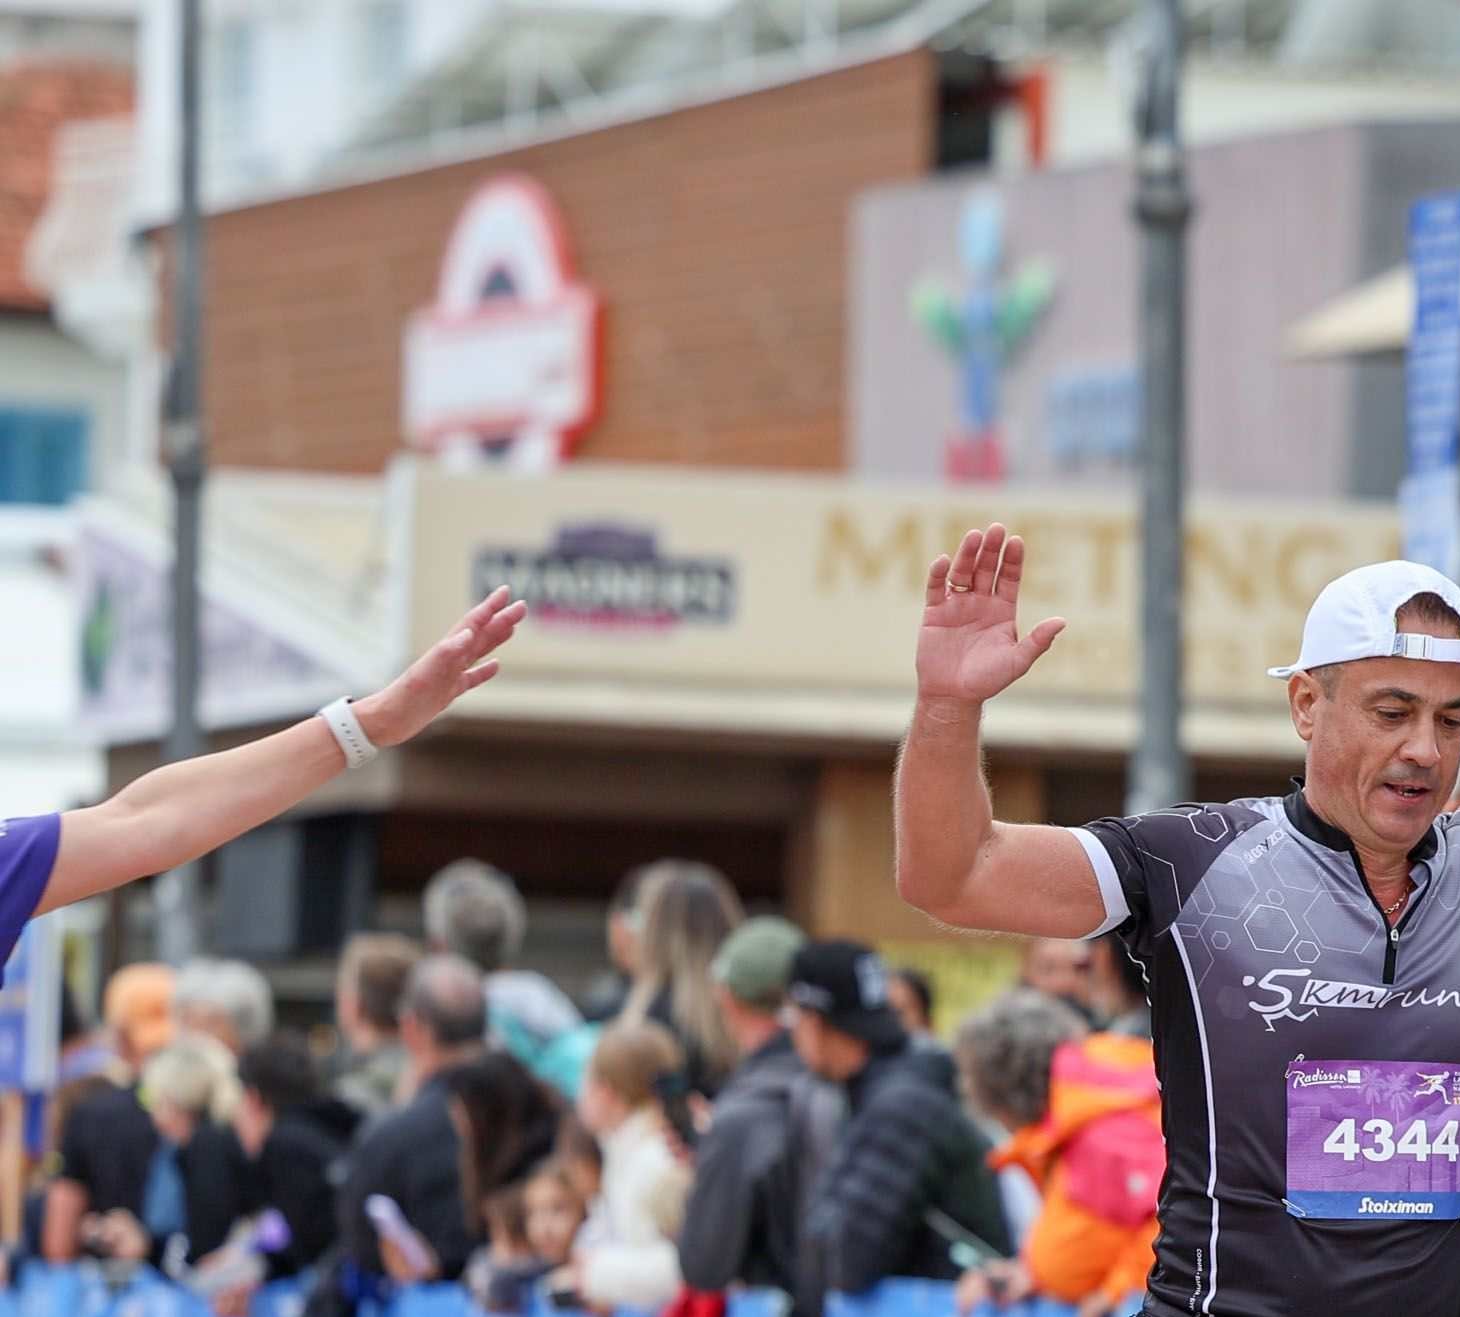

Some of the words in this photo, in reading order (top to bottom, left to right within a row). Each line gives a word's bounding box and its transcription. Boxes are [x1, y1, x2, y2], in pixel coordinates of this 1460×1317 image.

[816, 510, 1340, 602] METNG
[1323, 1118, 1460, 1162] 4344
[1358, 1197, 1434, 1214] Stoiximan
